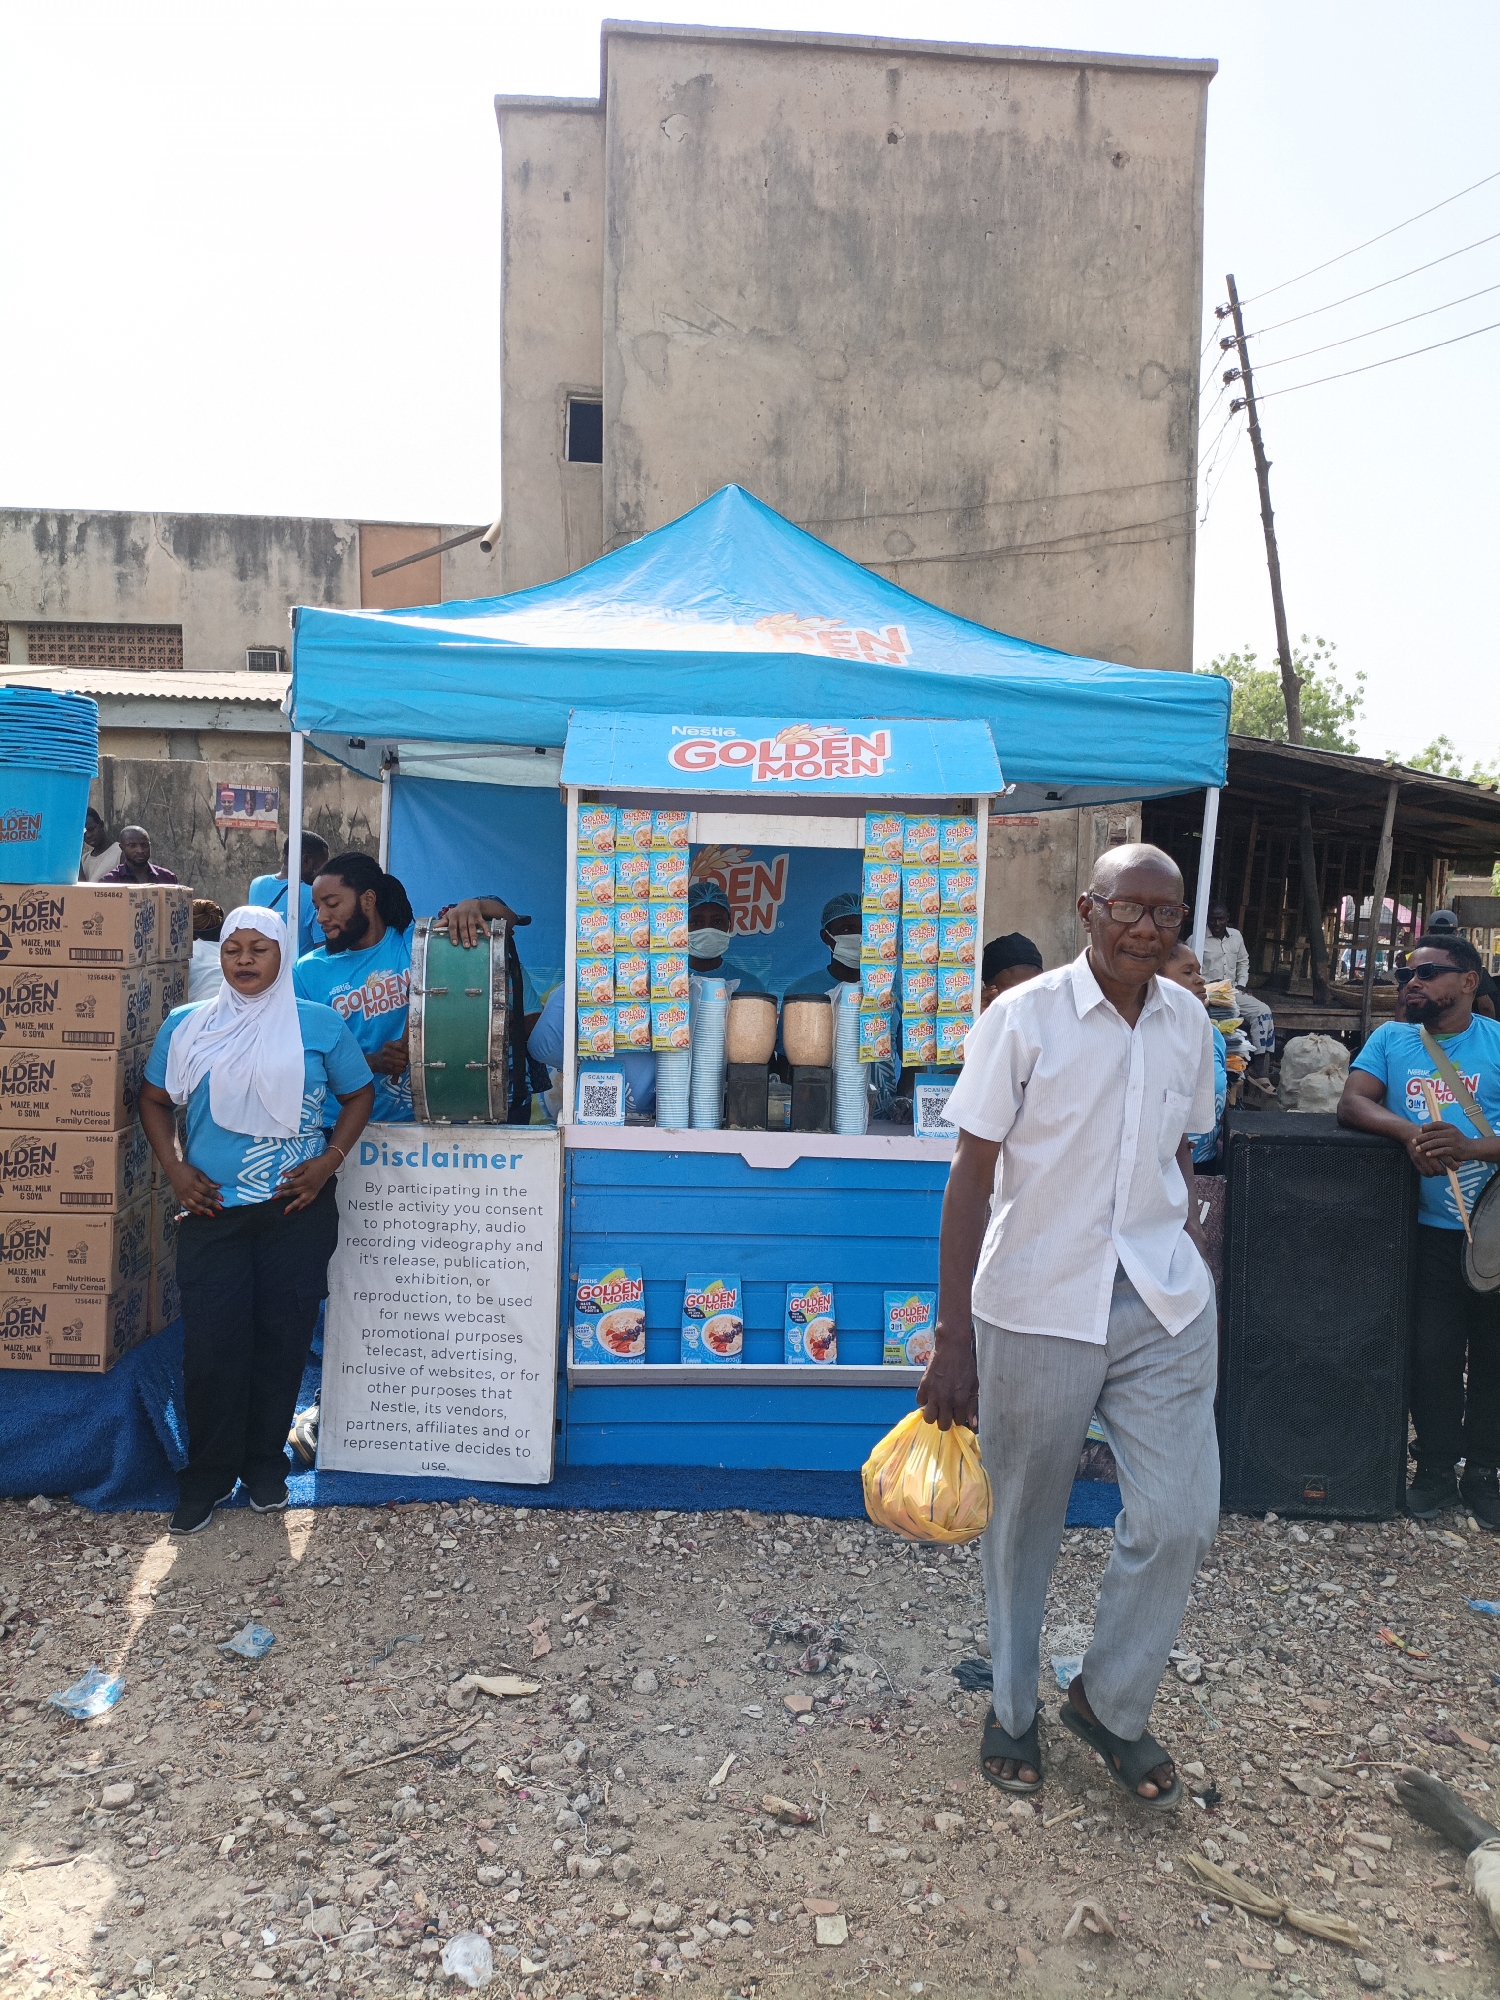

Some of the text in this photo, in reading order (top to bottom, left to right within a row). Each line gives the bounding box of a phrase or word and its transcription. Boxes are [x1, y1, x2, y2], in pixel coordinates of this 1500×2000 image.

[672, 725, 736, 737] Nestlé
[674, 732, 885, 769] GOLDEN
[758, 757, 879, 780] MORN
[0, 814, 41, 831] LDEN
[582, 814, 609, 824] GOLDEN
[908, 826, 936, 836] GOLDEN
[946, 826, 972, 836] GOLDEN
[581, 864, 608, 874] GOLDEN
[657, 861, 684, 871] GOLDEN
[908, 876, 936, 886] GOLDEN
[947, 876, 974, 886] GOLDEN
[0, 896, 64, 922] OLDEN
[620, 910, 647, 920] GOLDEN
[730, 902, 773, 933] RN
[12, 917, 61, 934] MORN
[44, 939, 61, 948] MILK
[35, 948, 52, 956] SOYA
[619, 960, 647, 970] GOLDEN
[657, 960, 684, 971] GOLDEN
[908, 977, 934, 986] GOLDEN
[945, 976, 970, 985] GOLDEN
[0, 980, 58, 1003] LDEN
[333, 969, 410, 1018] GOLDEN
[6, 1000, 54, 1016] MORN
[619, 1008, 646, 1018] GOLDEN
[658, 1010, 686, 1021] GOLDEN
[38, 1022, 54, 1030] MILK
[28, 1030, 45, 1038] SOYA
[0, 1060, 55, 1083] LDEN
[1, 1080, 50, 1095] MORN
[1408, 1099, 1414, 1108] 3
[1421, 1100, 1426, 1109] 1
[24, 1110, 40, 1118] SOYA
[70, 1109, 110, 1117] Nutritious
[56, 1117, 82, 1125] Family
[0, 1142, 57, 1166] LDEN
[360, 1142, 524, 1170] Disclaimer
[3, 1162, 52, 1180] MORN
[366, 1182, 527, 1199] By participating in the
[349, 1200, 543, 1216] Nestle activity you consent
[364, 1218, 526, 1235] to photography, audio
[0, 1226, 51, 1249] LDEN
[347, 1236, 543, 1254] recording videography and
[360, 1253, 529, 1272] it's release, publication,
[31, 1268, 46, 1276] MILK
[66, 1275, 105, 1283] Nutritious
[22, 1276, 37, 1284] SOYA
[53, 1283, 78, 1291] Family
[396, 1273, 491, 1288] exhibition, or
[578, 1279, 642, 1300] GOLDEN
[354, 1290, 532, 1307] reproduction, to be used
[602, 1292, 639, 1304] MORN
[686, 1290, 736, 1307] GOLDEN
[791, 1294, 830, 1311] GOLDEN
[705, 1302, 733, 1310] MORN
[807, 1305, 828, 1313] MORN
[891, 1304, 929, 1320] GOLDEN
[0, 1304, 47, 1326] DEN
[380, 1308, 506, 1324] for news webcast
[906, 1315, 927, 1323] MORN
[362, 1328, 523, 1345] promotional purposes
[26, 1344, 41, 1352] MILK
[365, 1344, 517, 1365] telecast, advertising,
[18, 1352, 32, 1360] SOYA
[342, 1362, 540, 1382] inclusive of websites, or for
[368, 1382, 512, 1400] other purposes that
[371, 1401, 507, 1420] Nestle, its vendors,
[346, 1420, 530, 1439] partners, affiliates and or
[344, 1439, 531, 1458] representative decides to
[422, 1462, 450, 1472] use.
